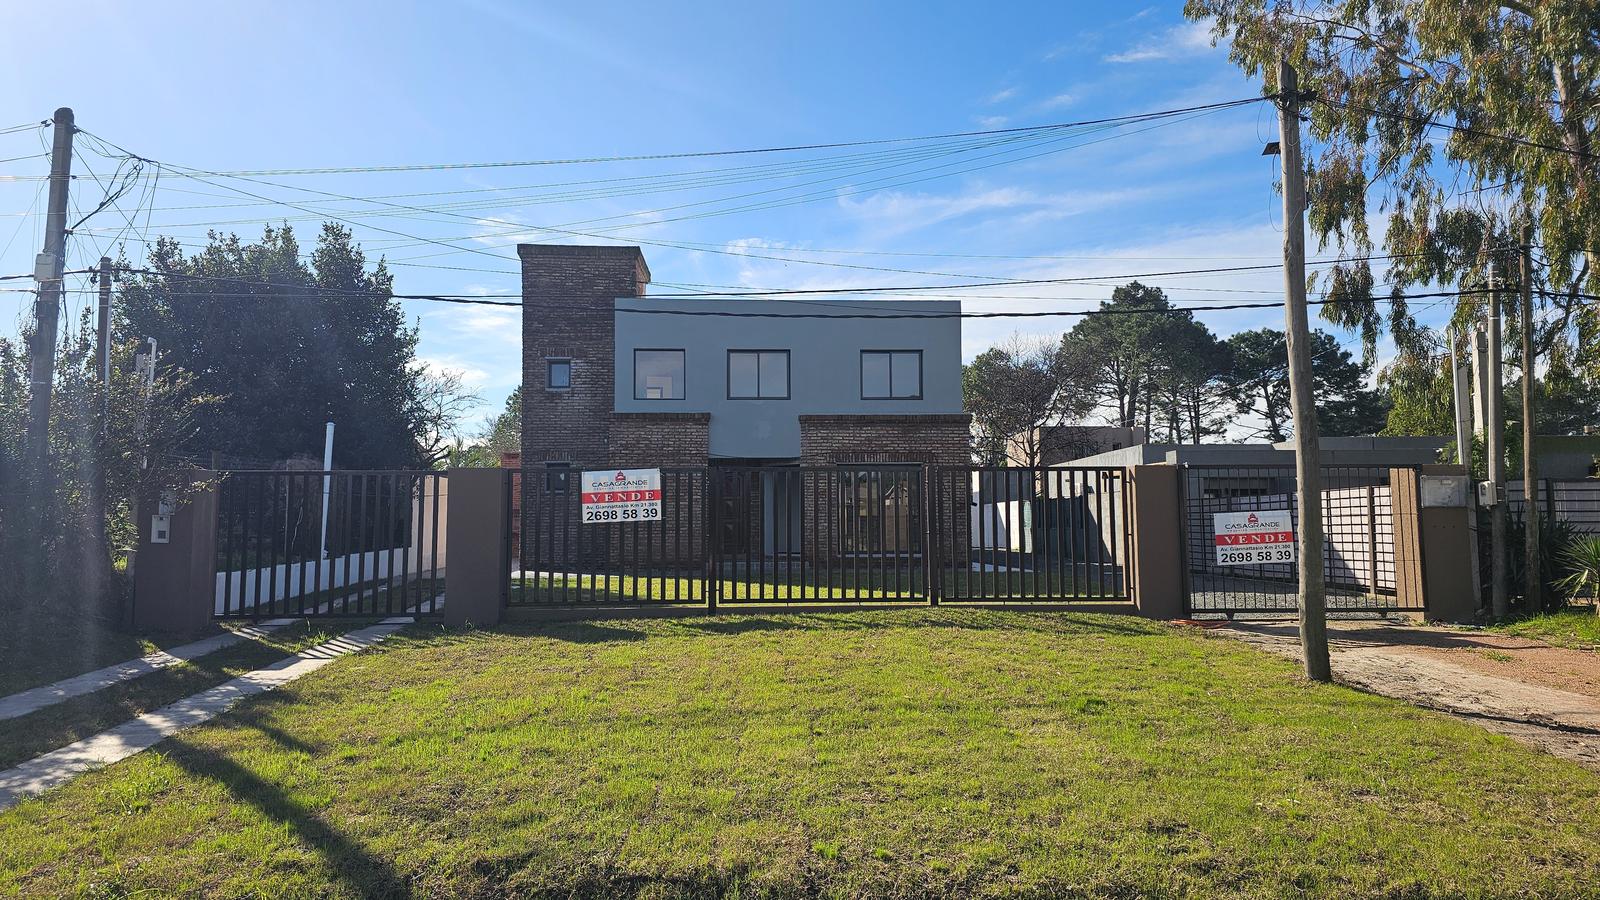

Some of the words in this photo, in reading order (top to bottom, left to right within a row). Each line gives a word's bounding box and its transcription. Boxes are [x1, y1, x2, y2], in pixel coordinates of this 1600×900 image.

[591, 480, 648, 488] CASAGRANDE
[590, 491, 654, 502] VENDE
[586, 510, 618, 521] 2698
[622, 509, 638, 519] 58
[642, 508, 658, 518] 39
[1224, 522, 1280, 530] CASAGRANDE
[1225, 533, 1287, 544] VENDE
[1221, 552, 1253, 563] 2698
[1257, 551, 1272, 561] 58
[1276, 550, 1291, 560] 39
